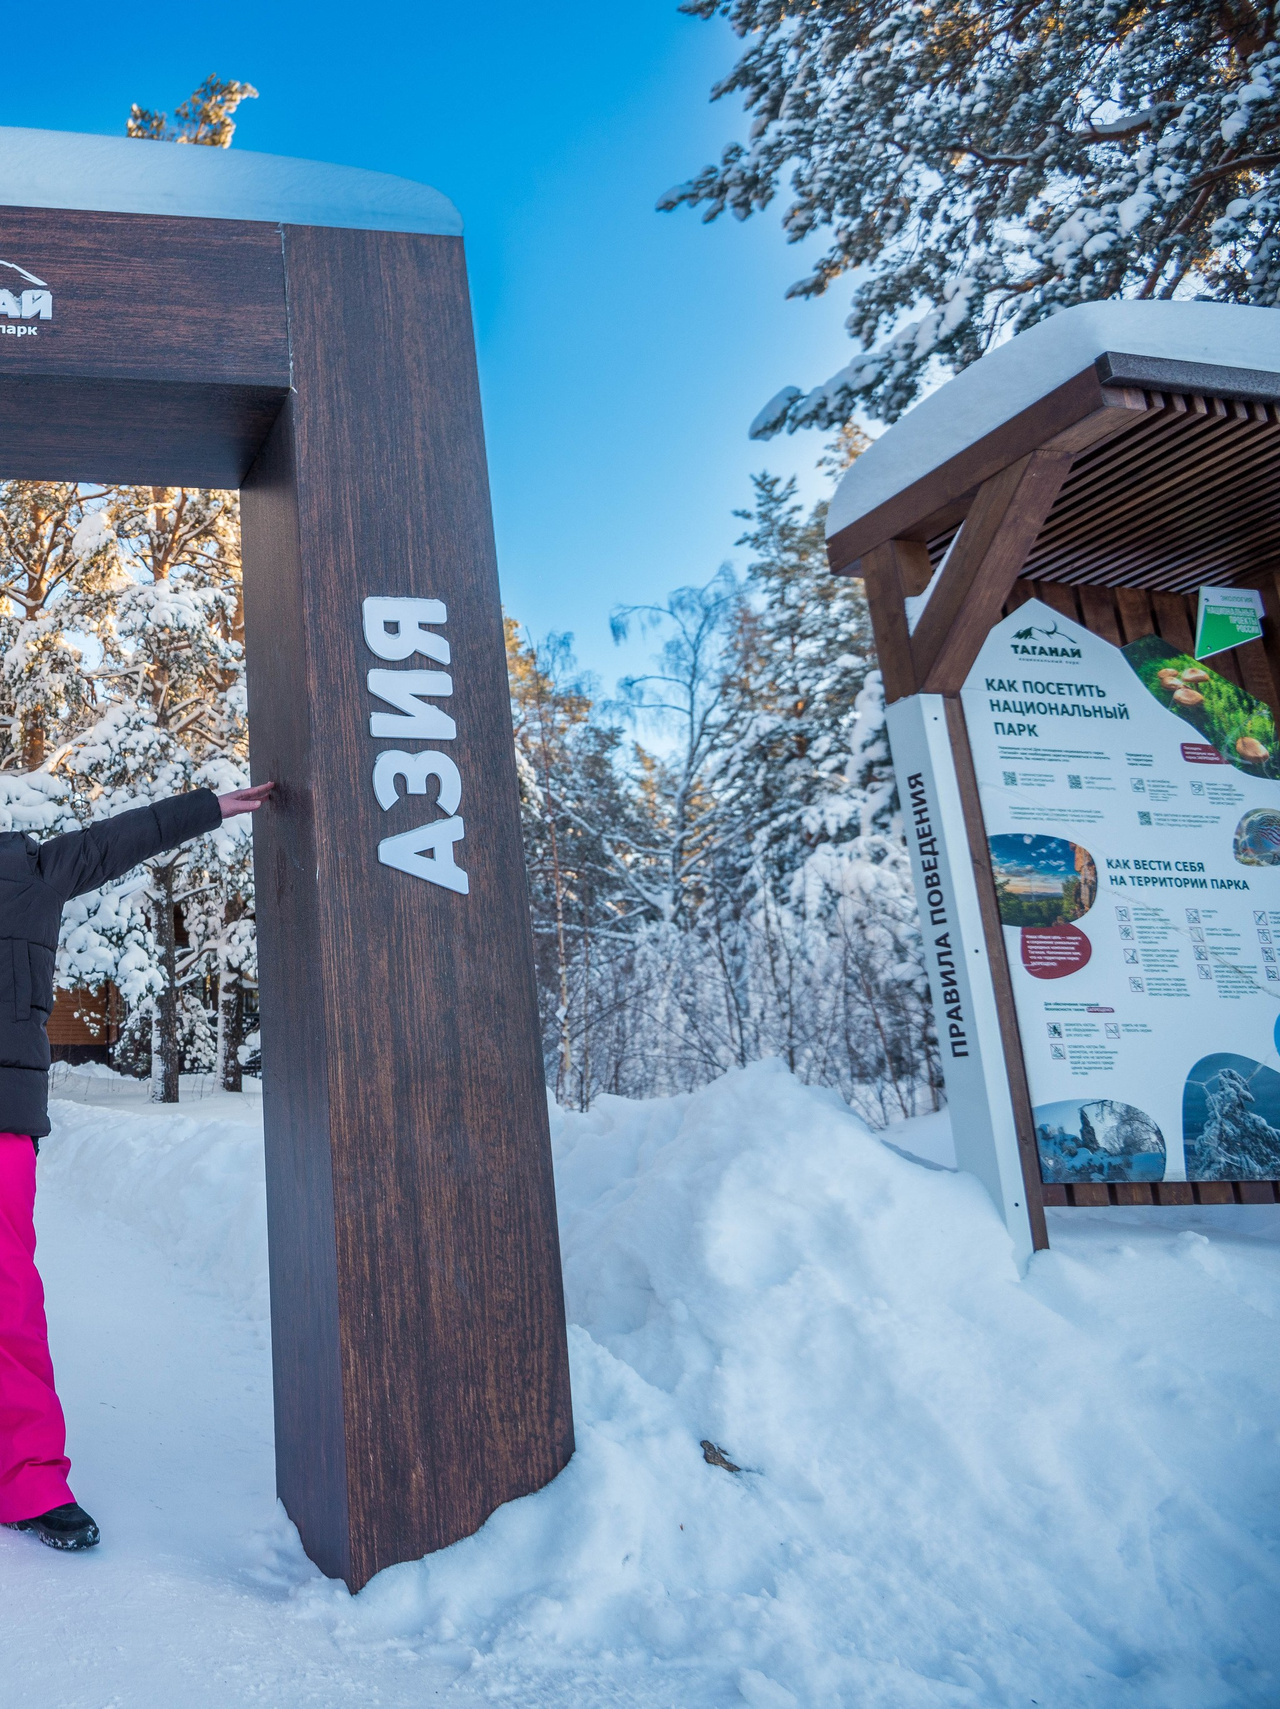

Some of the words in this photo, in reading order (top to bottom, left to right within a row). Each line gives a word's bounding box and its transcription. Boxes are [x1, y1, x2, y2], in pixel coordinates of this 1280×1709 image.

[1011, 644, 1082, 659] ТАГАНАЙ
[985, 678, 1018, 693] КАК
[1023, 680, 1106, 698] ПОСЕТИТЬ
[989, 699, 1130, 720] НАЦИОНАЛЬНЫЙ
[994, 722, 1039, 737] ПАРК
[363, 596, 469, 895] АЗИЯ
[907, 773, 947, 925] ПОВЕДЕНИЯ
[1106, 859, 1130, 871] КАК
[1134, 860, 1171, 872] ВЕСТИ
[1174, 861, 1205, 873] СЕБЯ
[1110, 875, 1127, 886] НА
[1129, 876, 1208, 889] ТЕРРИТОРИИ
[1210, 878, 1250, 891] ПАРКА
[931, 932, 969, 1057] ПРАВИЛА
